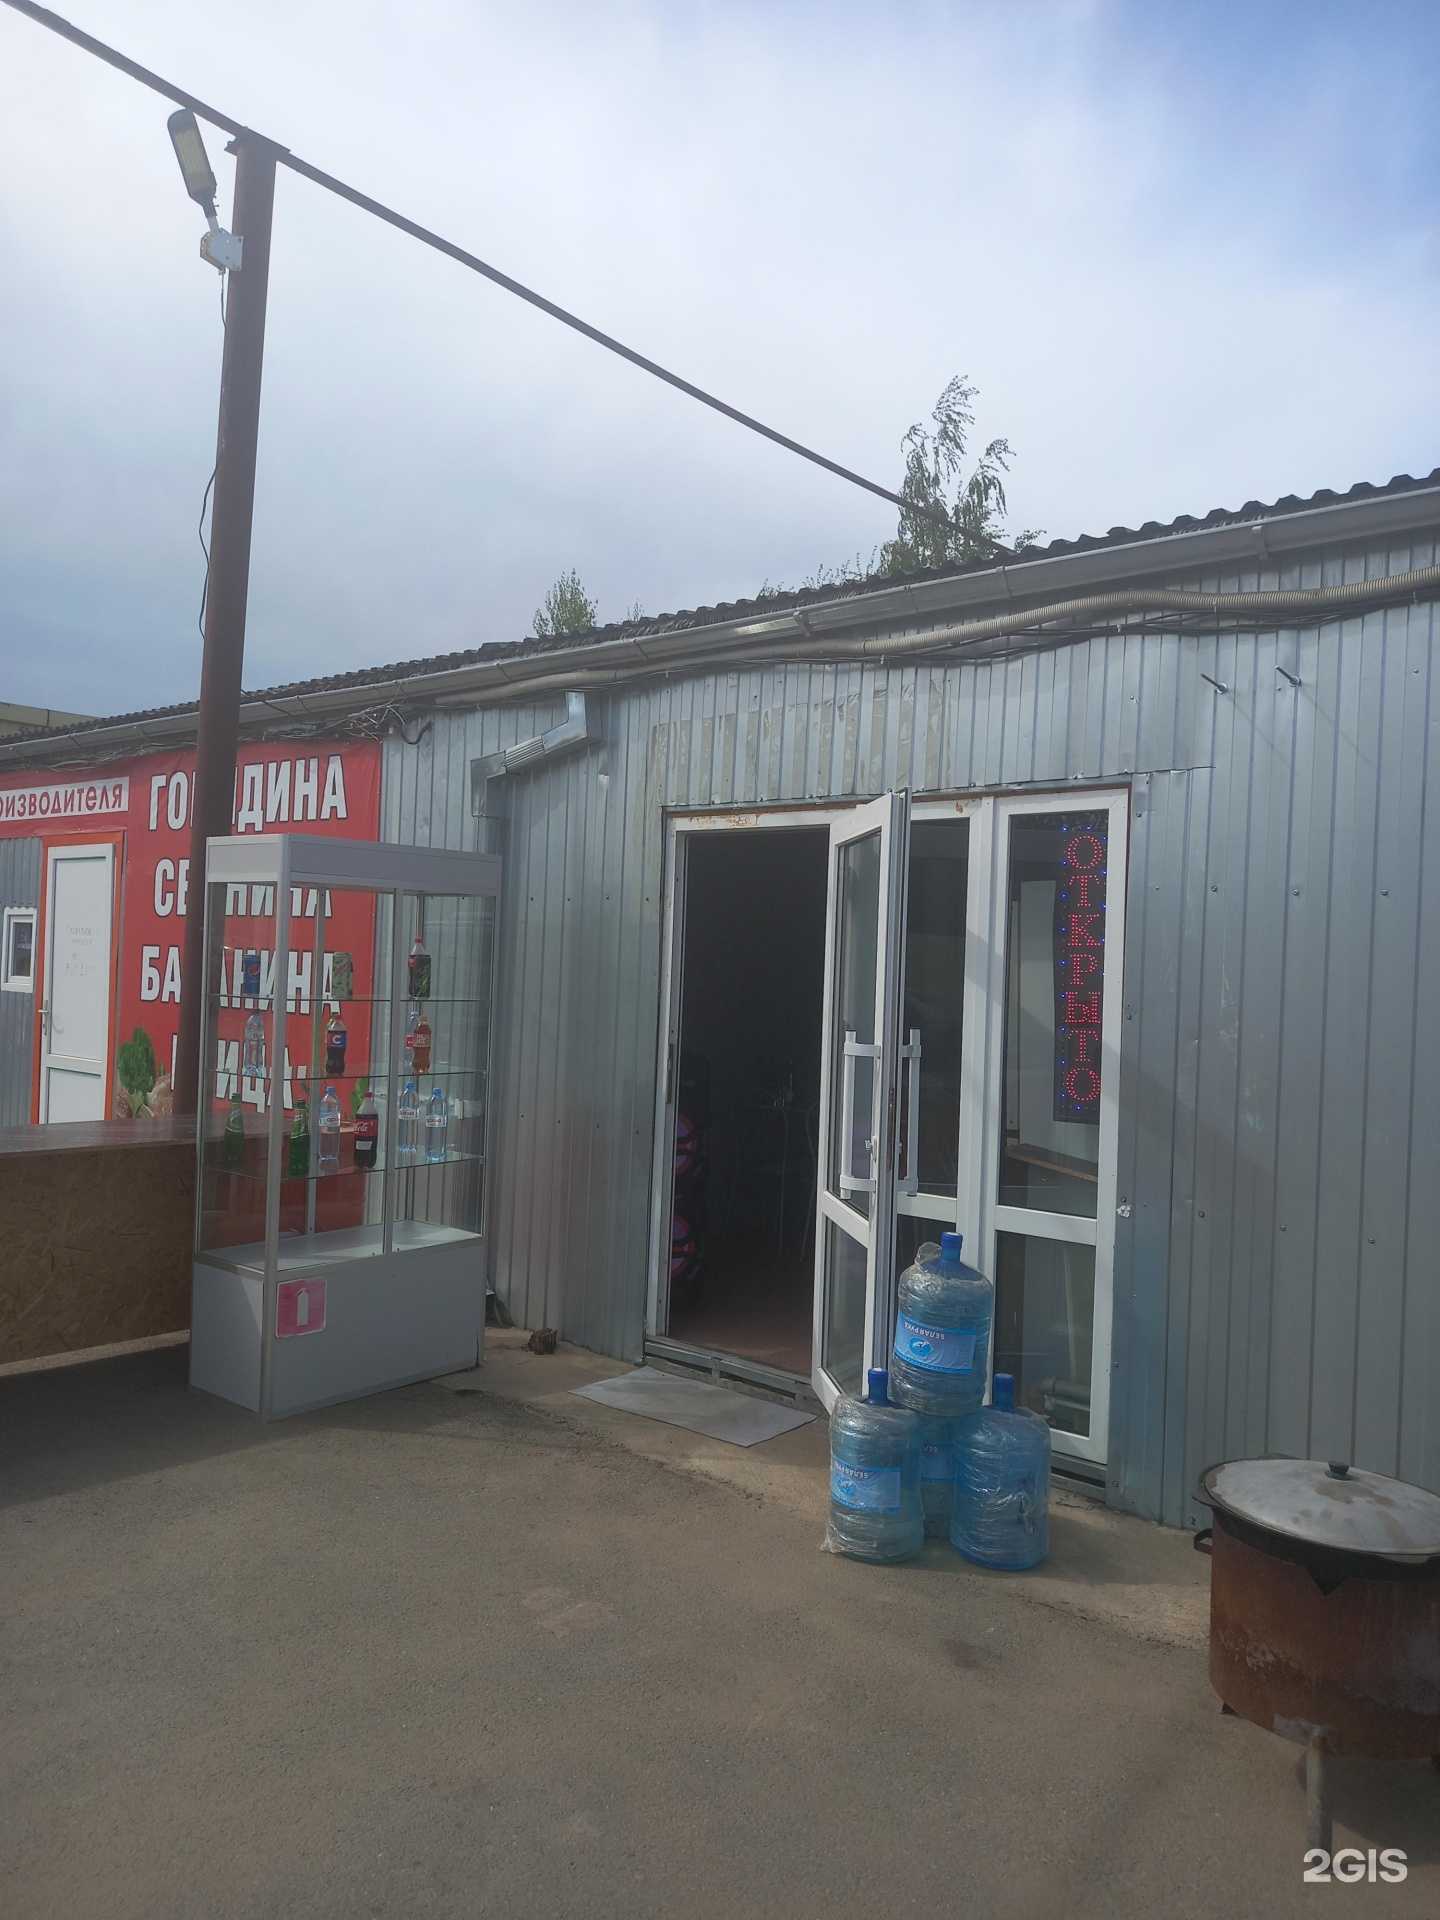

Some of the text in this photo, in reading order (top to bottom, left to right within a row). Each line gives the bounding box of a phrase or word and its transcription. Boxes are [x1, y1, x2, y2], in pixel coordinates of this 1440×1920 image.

[0, 783, 123, 818] ИЗВОДИТЕЛЯ
[149, 755, 347, 832] ГОДИНА
[1065, 835, 1103, 1101] ОТКРЫТО
